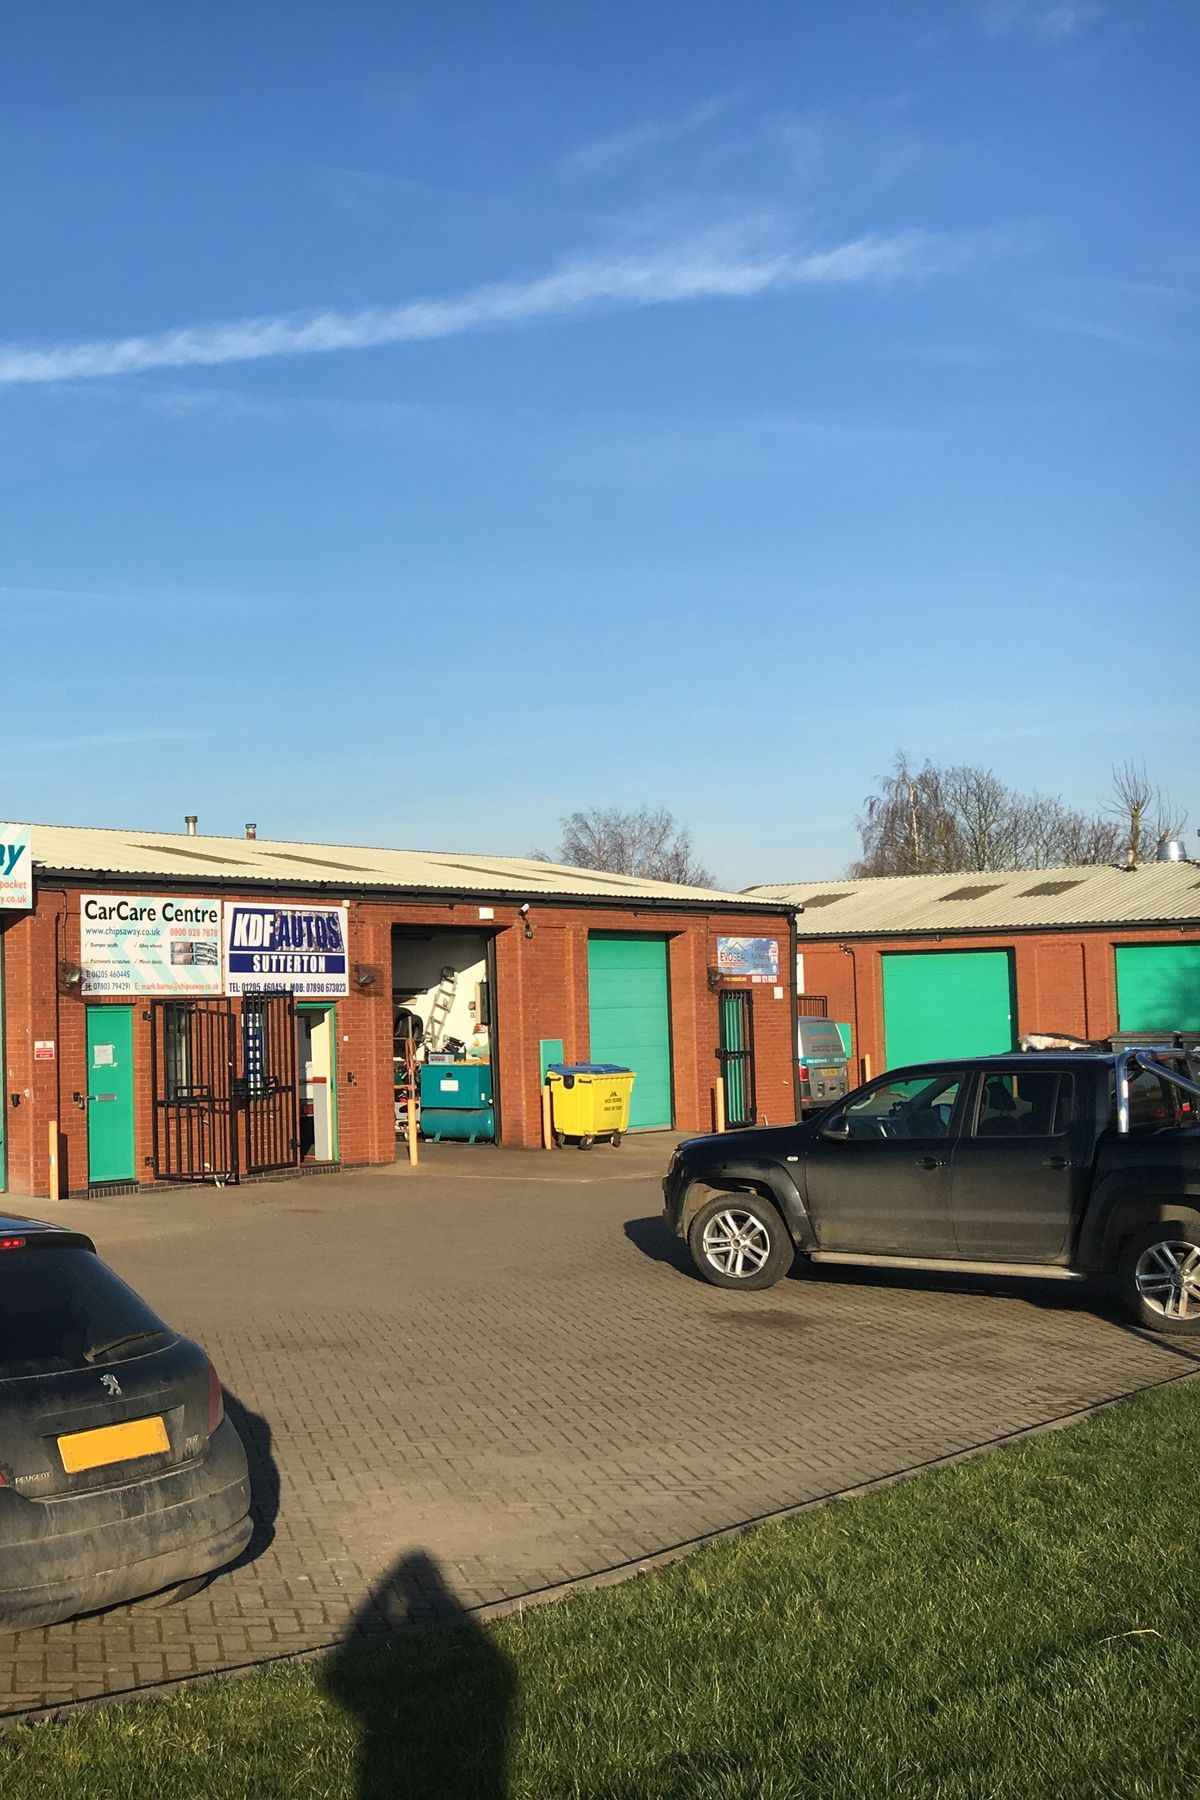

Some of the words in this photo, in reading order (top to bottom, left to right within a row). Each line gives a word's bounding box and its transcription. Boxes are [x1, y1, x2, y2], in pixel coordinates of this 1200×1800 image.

[0, 879, 27, 890] pocket
[84, 899, 157, 922] CarCare
[162, 902, 218, 923] Centre
[85, 927, 161, 938] www.chipsaway.co.uk
[170, 927, 187, 937] 0800
[188, 928, 200, 937] 028
[202, 928, 218, 937] 7878
[233, 913, 274, 947] KDF
[278, 914, 341, 949] AUTOS
[252, 954, 326, 973] SUTTERTON
[229, 982, 241, 993] TEL:
[14, 1471, 51, 1485] PEUGEOT
